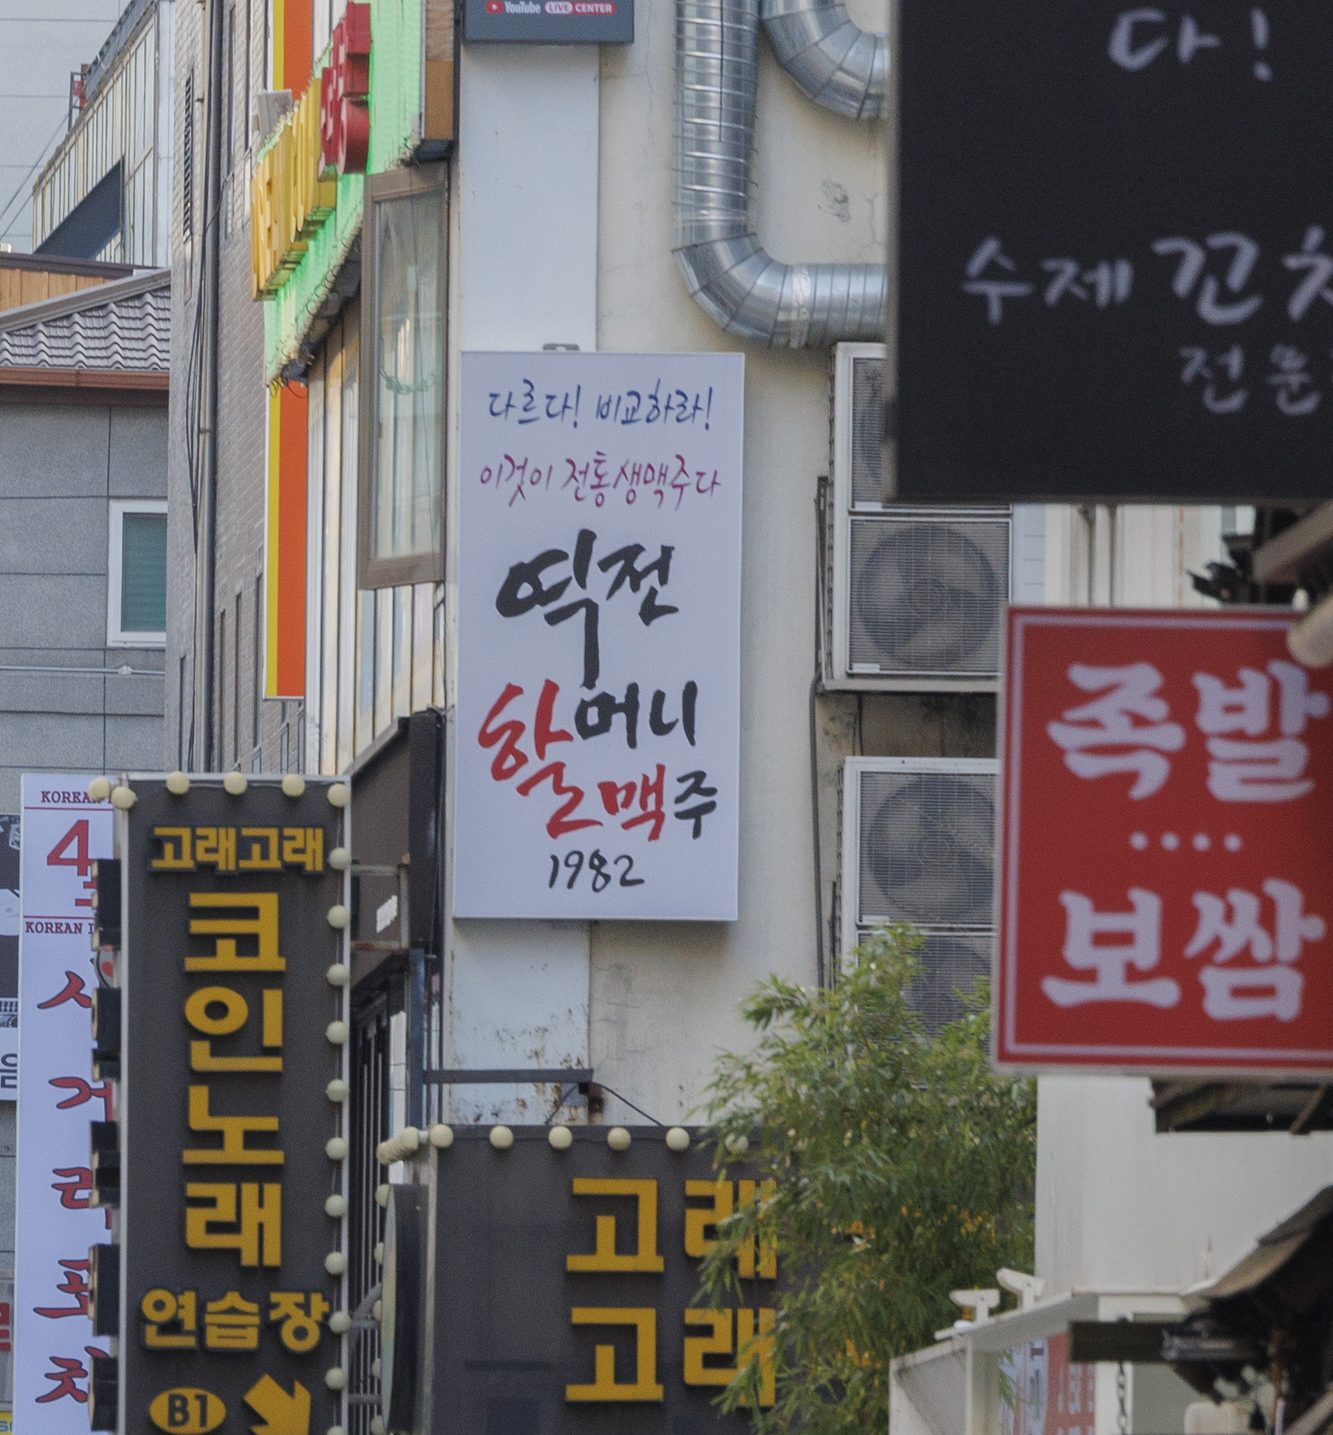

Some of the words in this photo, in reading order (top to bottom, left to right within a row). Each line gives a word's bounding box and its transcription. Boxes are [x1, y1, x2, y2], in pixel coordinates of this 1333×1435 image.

[504, 1, 541, 14] YouTube
[575, 3, 613, 13] CENTER
[962, 236, 1135, 324] 수제
[488, 379, 581, 428] 다르다!
[594, 378, 713, 430] 비교하라!
[480, 454, 554, 507] 이것이
[561, 450, 722, 511] 전통생맥주다
[496, 529, 680, 691] 역전
[478, 678, 700, 842] 할머니
[1046, 659, 1330, 802] 족발
[597, 762, 718, 843] 맥주
[149, 826, 325, 872] 고래고래
[549, 849, 646, 893] 1982
[25, 921, 84, 935] KOREAN
[1040, 877, 1328, 1022] 보쌈
[182, 891, 288, 1269] 코인노래
[566, 1177, 779, 1281] 고래
[140, 1287, 330, 1354] 연습장
[565, 1306, 777, 1408] 고래
[167, 1394, 210, 1429] B1
